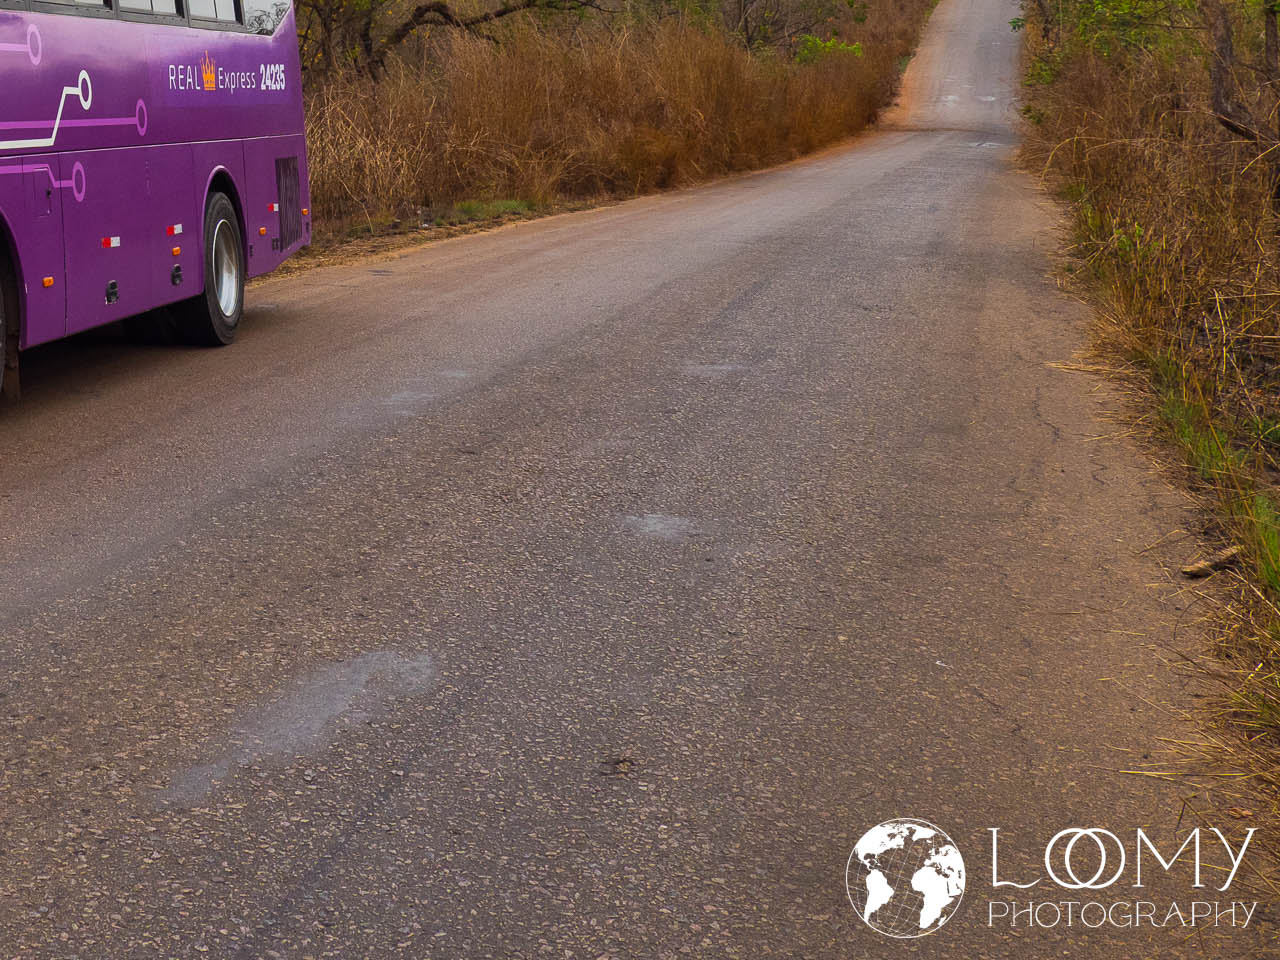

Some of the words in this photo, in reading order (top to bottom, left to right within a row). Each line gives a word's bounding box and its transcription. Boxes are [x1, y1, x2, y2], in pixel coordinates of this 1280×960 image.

[169, 64, 201, 90] REAL
[218, 67, 256, 94] Express
[260, 64, 286, 91] 24235
